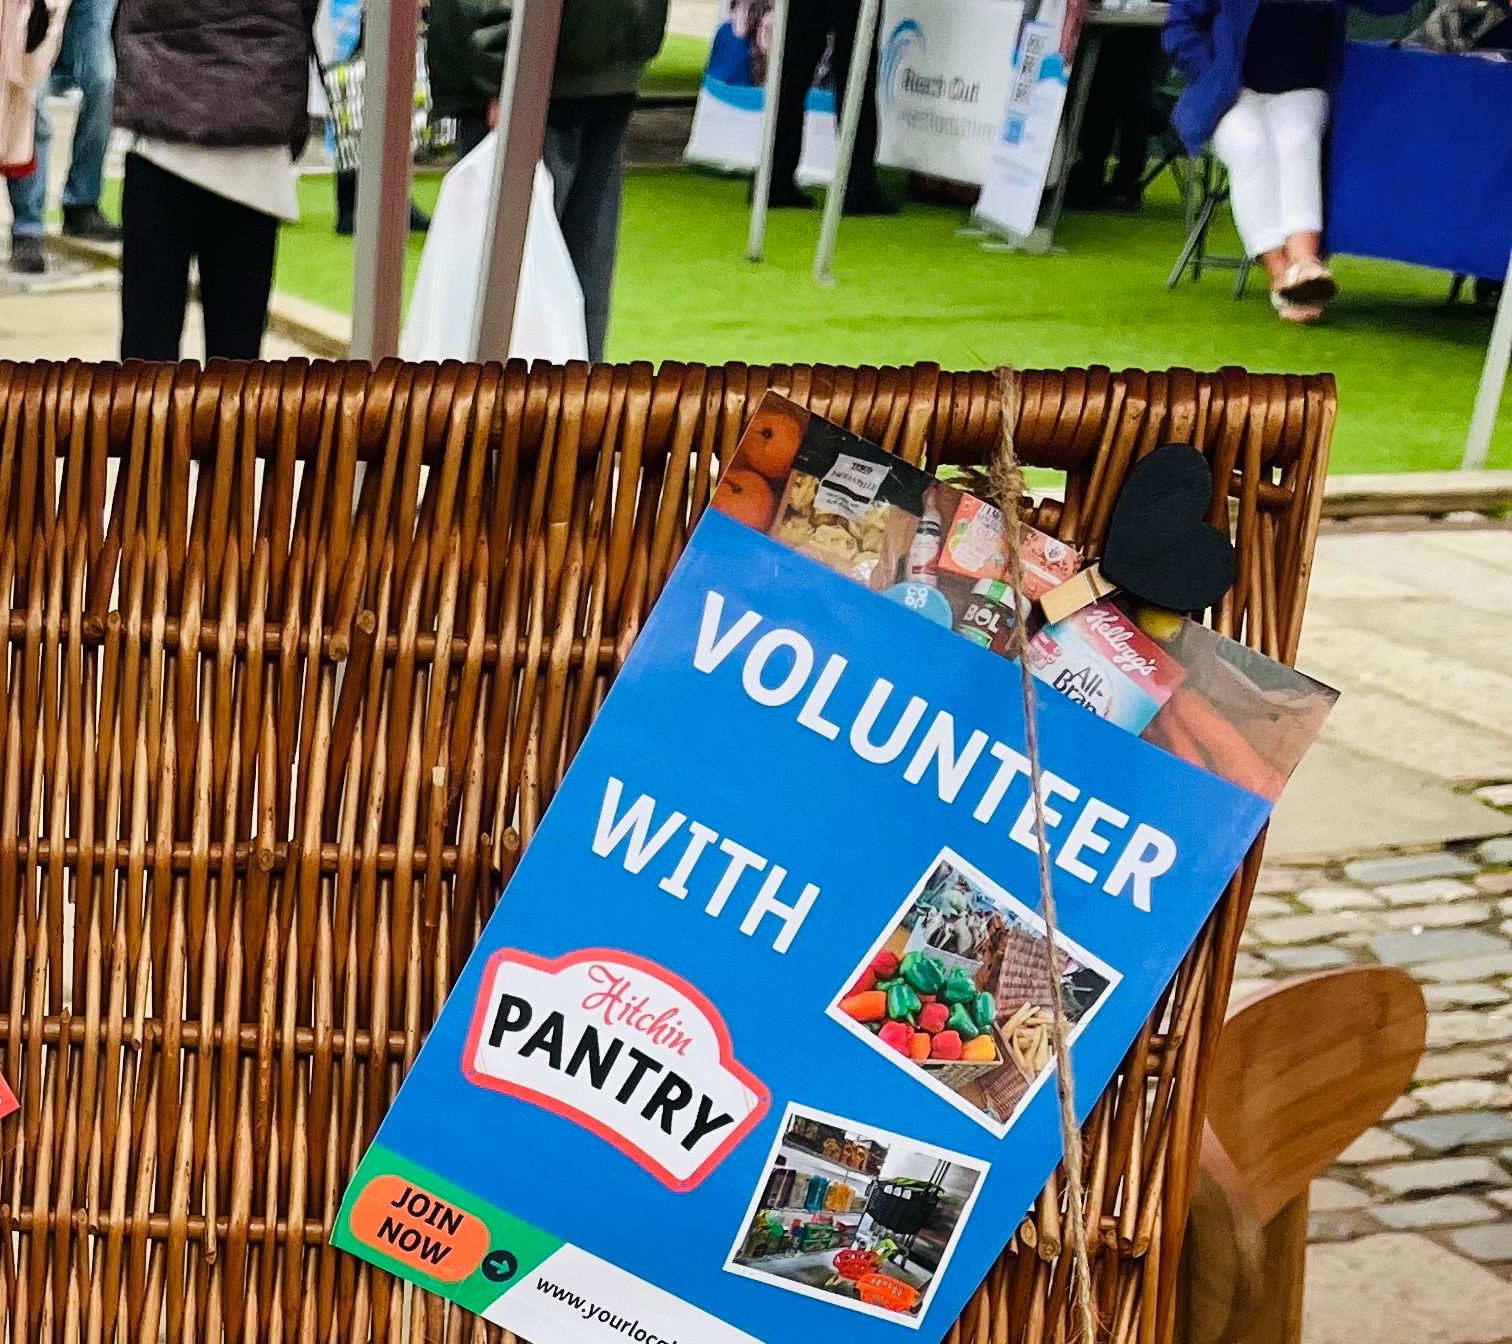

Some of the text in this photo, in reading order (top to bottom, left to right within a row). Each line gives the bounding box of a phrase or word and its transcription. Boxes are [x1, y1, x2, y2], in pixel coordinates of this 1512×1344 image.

[1086, 609, 1158, 676] Kellogg's
[692, 590, 1179, 913] VOLUNTEER
[591, 776, 821, 955] WITH
[581, 964, 693, 1056] Hitchin
[488, 993, 735, 1152] PANTRY
[376, 1217, 452, 1266] NOW
[391, 1187, 465, 1236] JOIN
